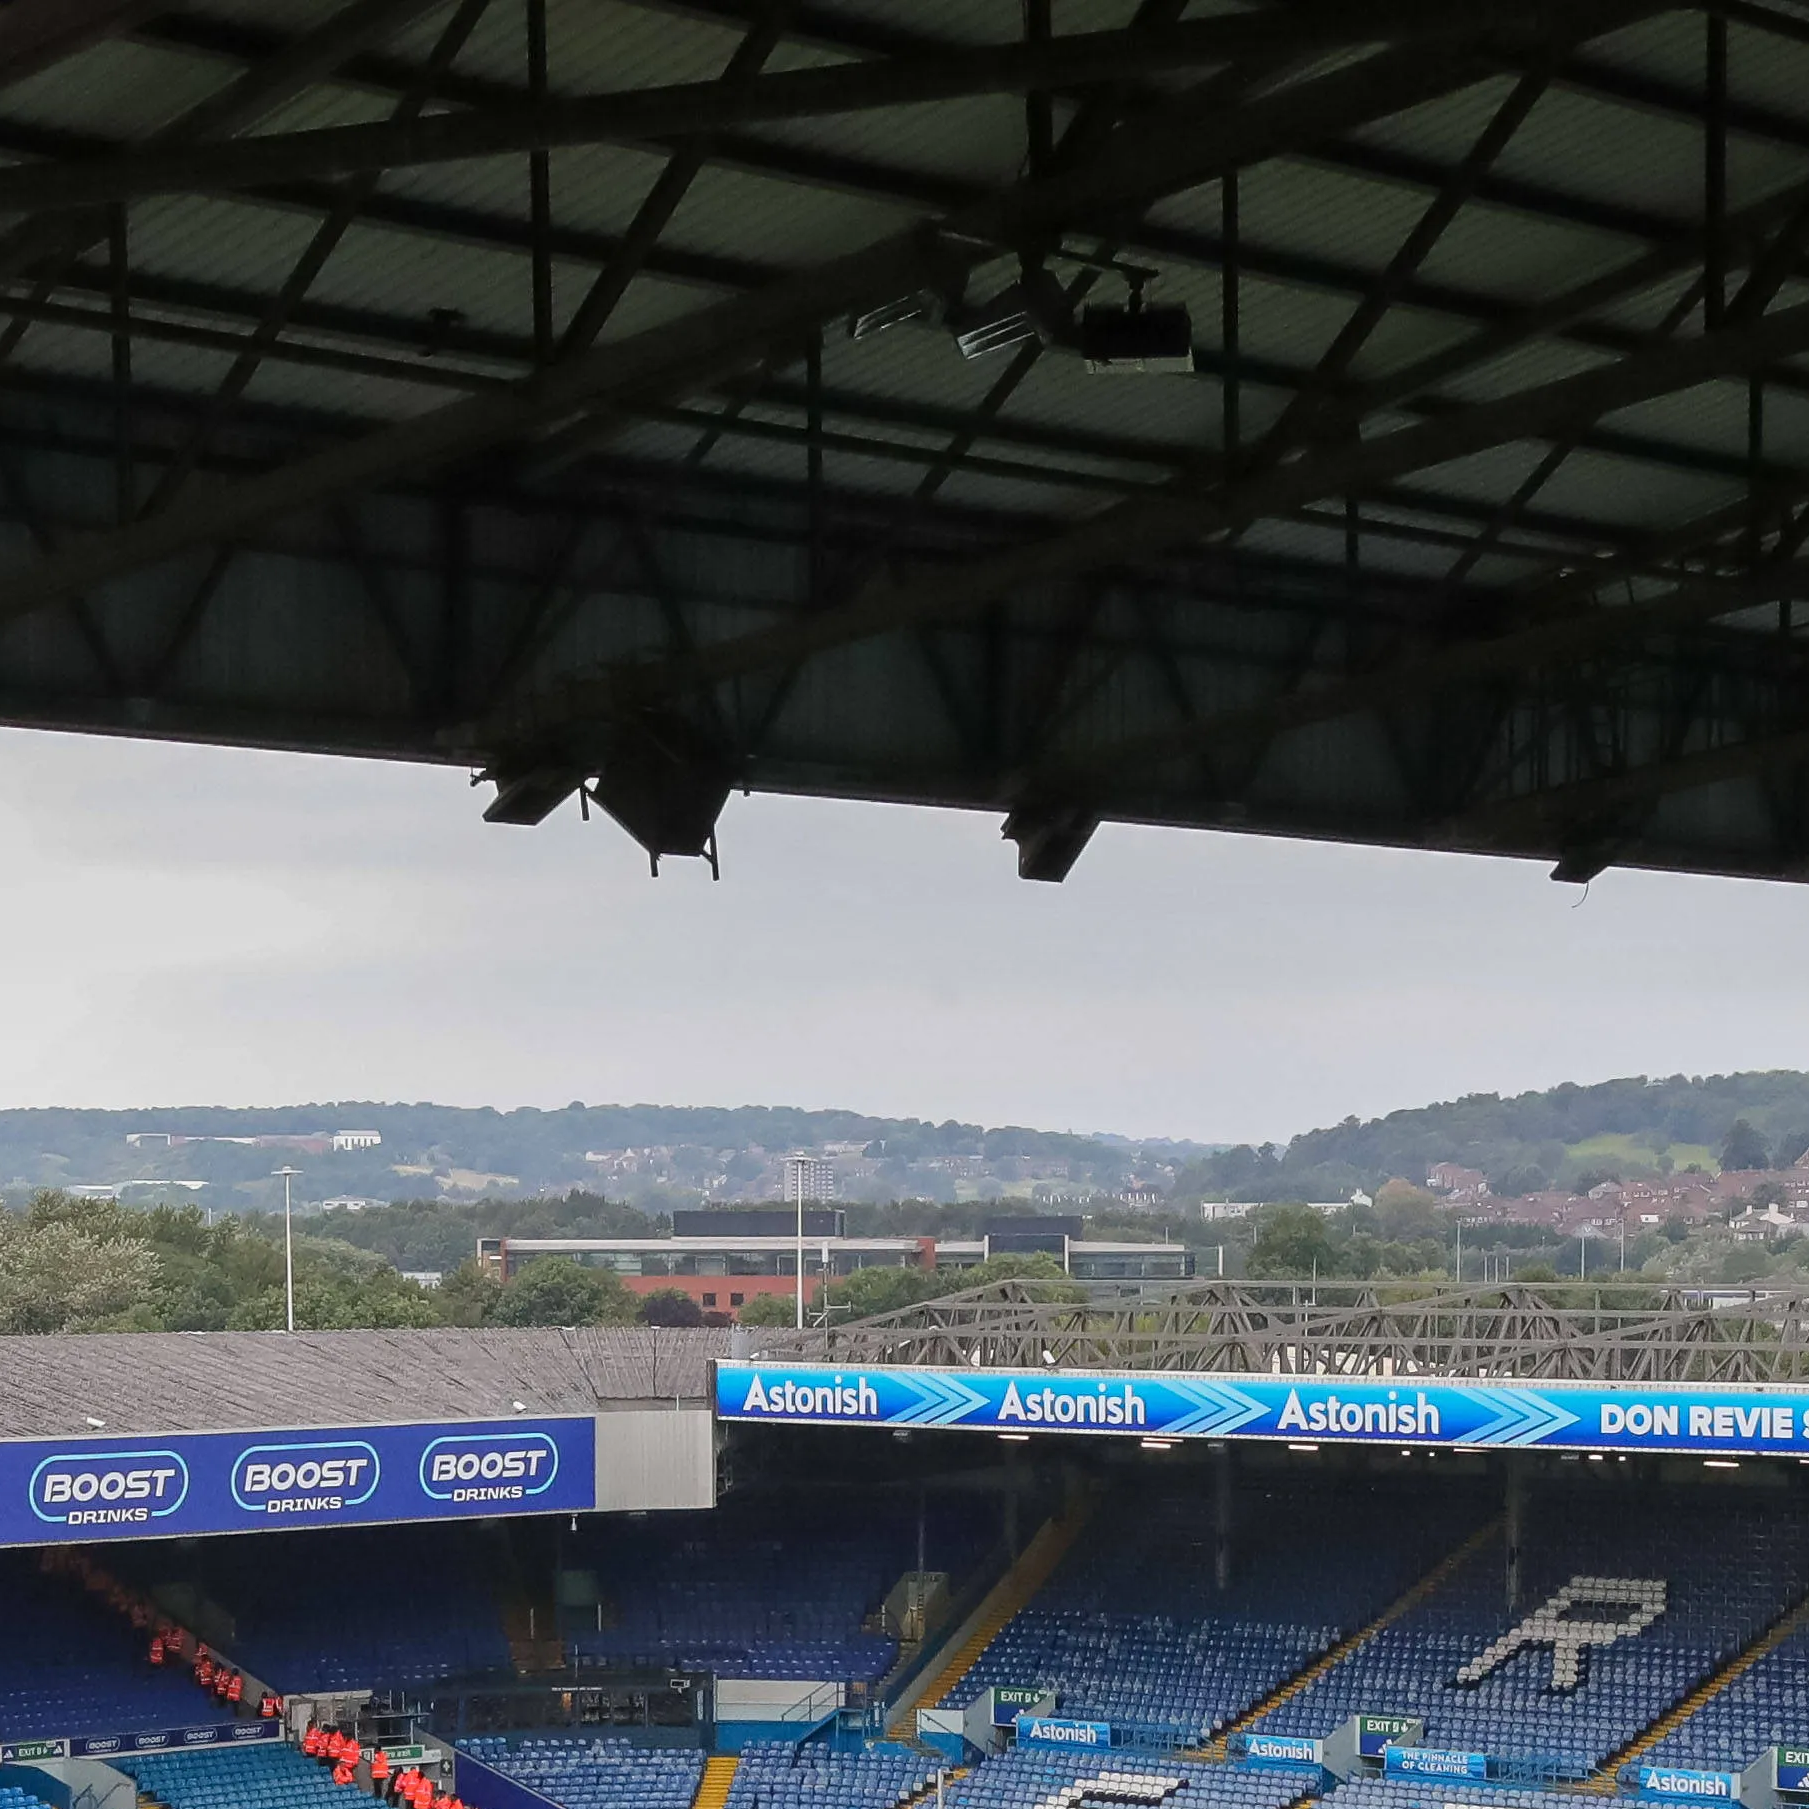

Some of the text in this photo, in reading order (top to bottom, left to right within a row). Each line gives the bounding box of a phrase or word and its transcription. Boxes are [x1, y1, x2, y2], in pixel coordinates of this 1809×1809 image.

[743, 1374, 877, 1414] Astonish
[998, 1381, 1144, 1424] Astonish
[1277, 1388, 1439, 1434] Astonish
[1601, 1404, 1678, 1435] DON
[1690, 1406, 1793, 1438] REVIE
[245, 1459, 367, 1491] BOOST
[432, 1450, 546, 1481] BOOST
[44, 1469, 175, 1502] BOOST
[450, 1486, 522, 1501] DRINKS
[268, 1497, 341, 1512] DRINKS
[69, 1508, 147, 1524] DRINKS
[1001, 1691, 1026, 1702] EXIT
[188, 1730, 212, 1741] BOOST
[1030, 1722, 1098, 1743] Astonish
[1367, 1720, 1390, 1732] EXIT
[140, 1735, 166, 1746] BOOST
[1249, 1738, 1315, 1761] Astonish
[1401, 1750, 1469, 1765] THE PINNACLE
[1402, 1761, 1467, 1774] OF CLEANING
[1647, 1770, 1726, 1795] Astonish
